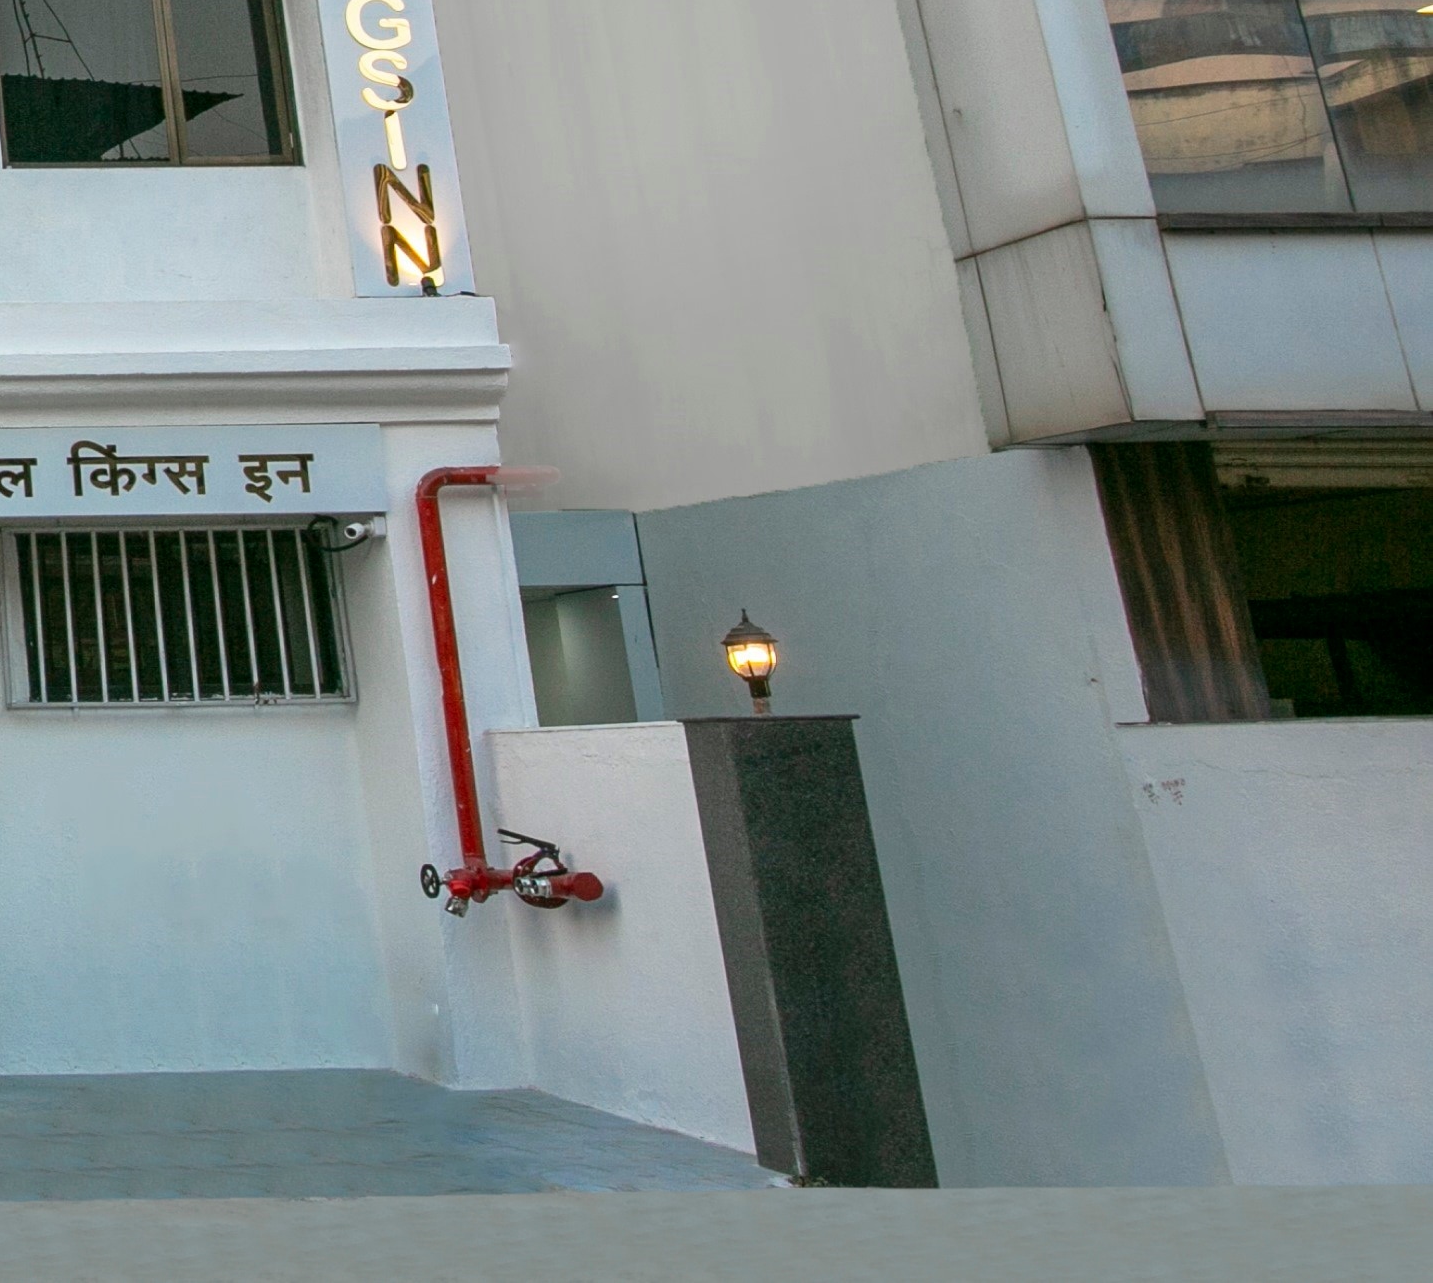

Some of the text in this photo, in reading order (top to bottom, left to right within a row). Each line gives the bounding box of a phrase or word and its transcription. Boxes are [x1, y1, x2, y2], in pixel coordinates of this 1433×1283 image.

[373, 109, 445, 288] INN
[66, 440, 209, 497] किंग्स
[238, 453, 314, 503] इन
